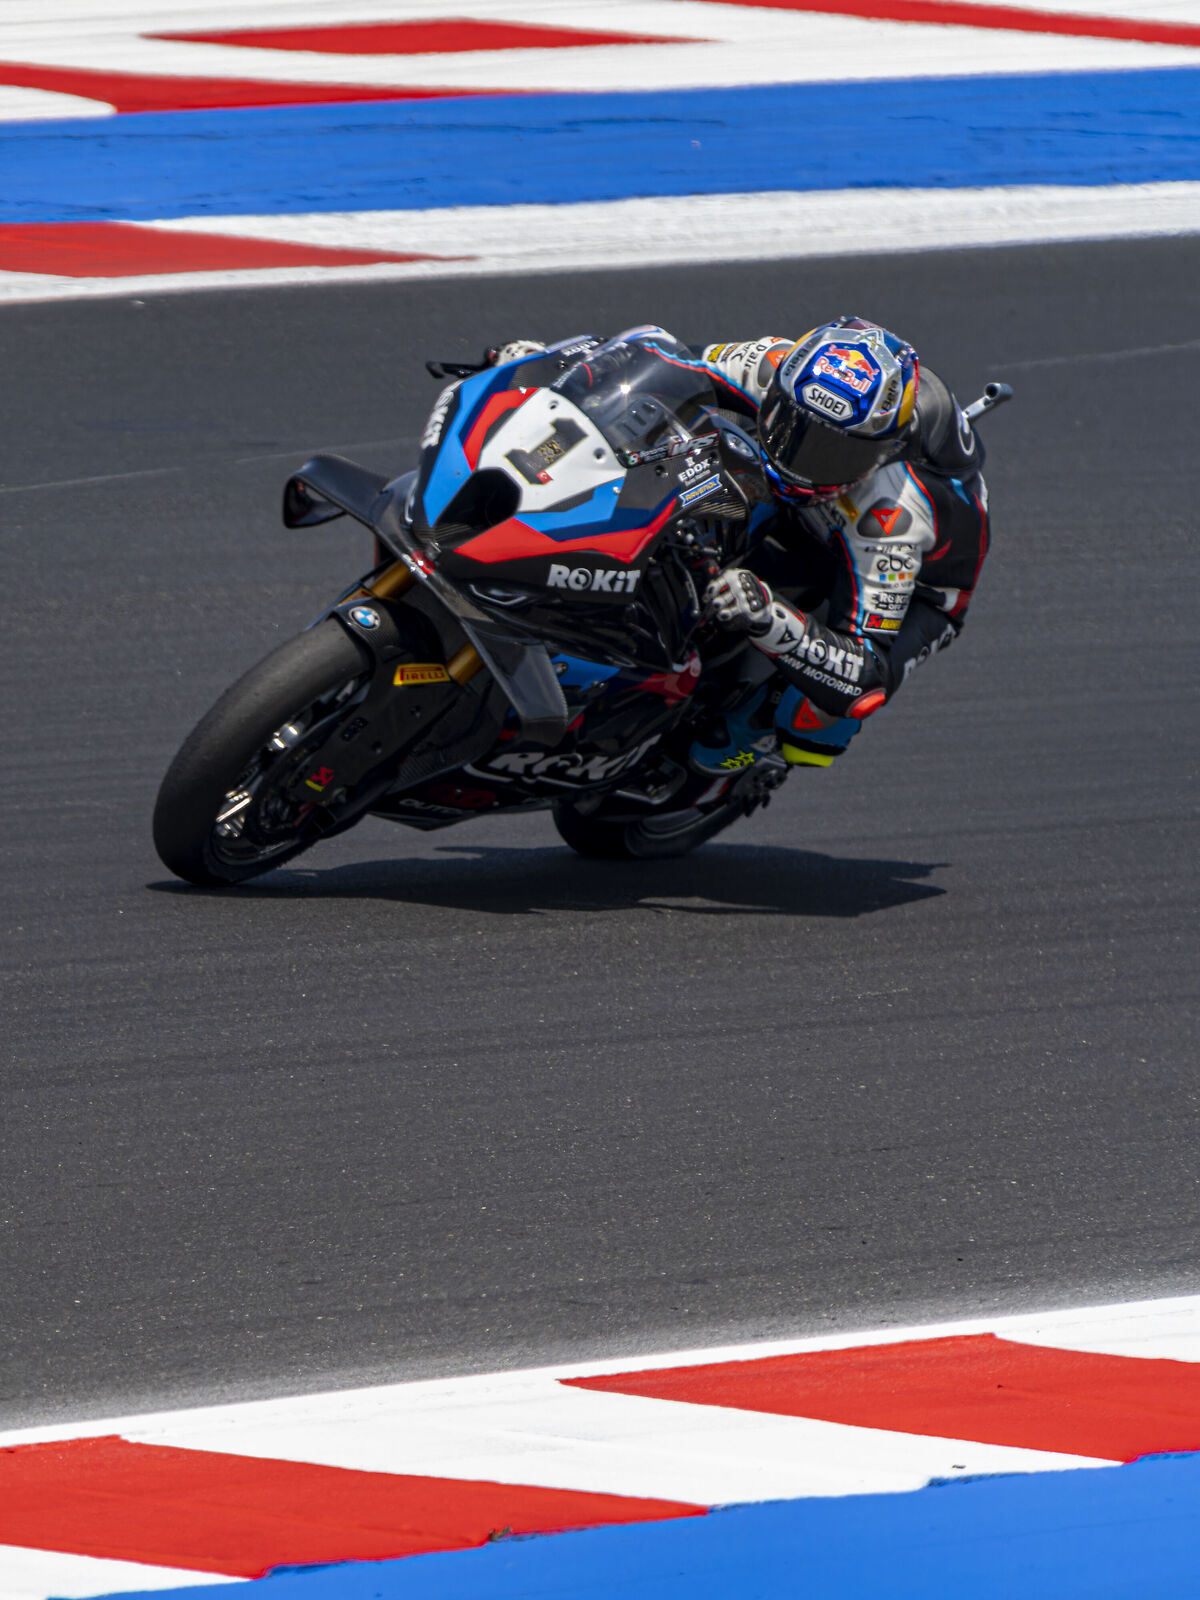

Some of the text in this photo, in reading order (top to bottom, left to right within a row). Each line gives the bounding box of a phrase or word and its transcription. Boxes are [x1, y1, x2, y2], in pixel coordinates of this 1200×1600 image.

[842, 369, 873, 394] Bull
[808, 388, 846, 416] SHOEI
[504, 417, 589, 485] 1
[678, 458, 711, 482] EDOX
[399, 666, 446, 682] PIRELLI
